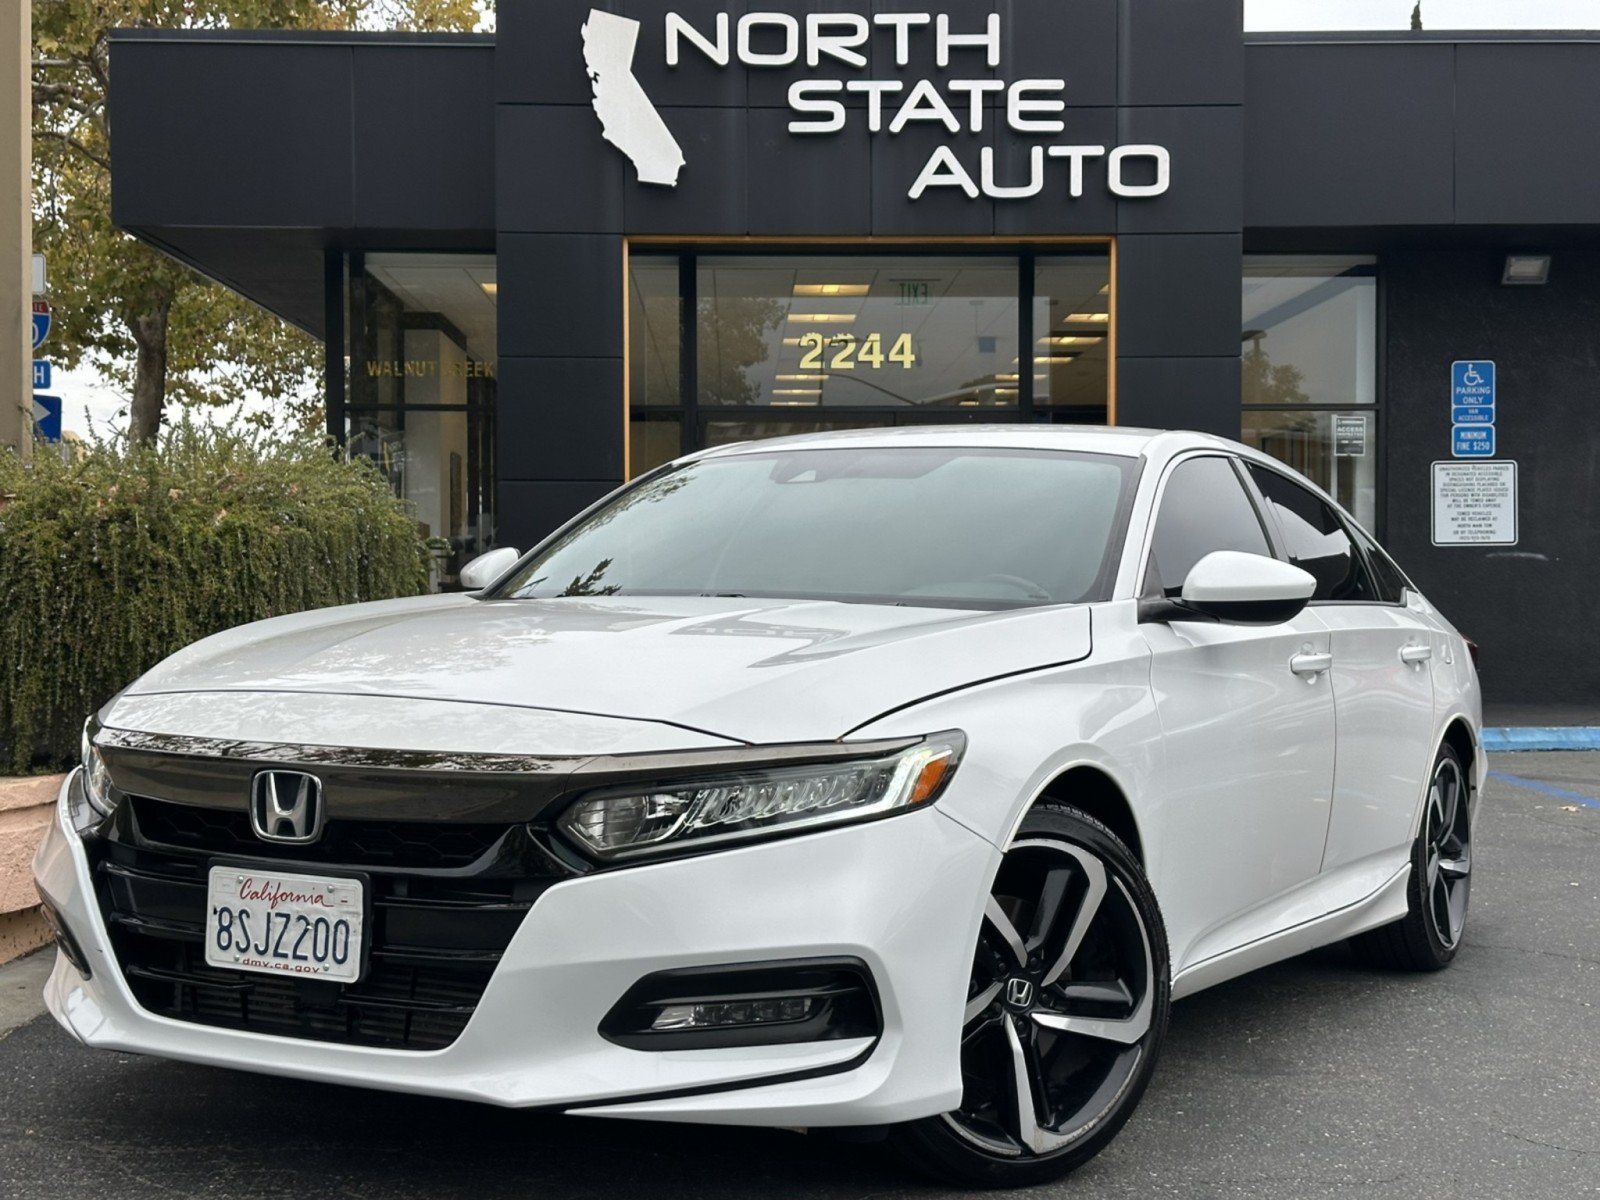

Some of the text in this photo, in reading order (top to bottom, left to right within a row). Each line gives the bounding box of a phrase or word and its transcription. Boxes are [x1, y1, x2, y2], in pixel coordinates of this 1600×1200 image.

[665, 11, 1000, 68] NORTH
[787, 78, 1066, 134] STATE
[907, 144, 1171, 200] AUTO
[799, 331, 916, 369] 2244
[366, 360, 496, 377] WALNUT REEK
[1462, 396, 1484, 404] ONLY
[1456, 441, 1490, 450] FINE $250
[239, 878, 335, 910] California
[216, 906, 351, 965] 8SJZ200
[242, 958, 321, 974] dmv.ca.gov
